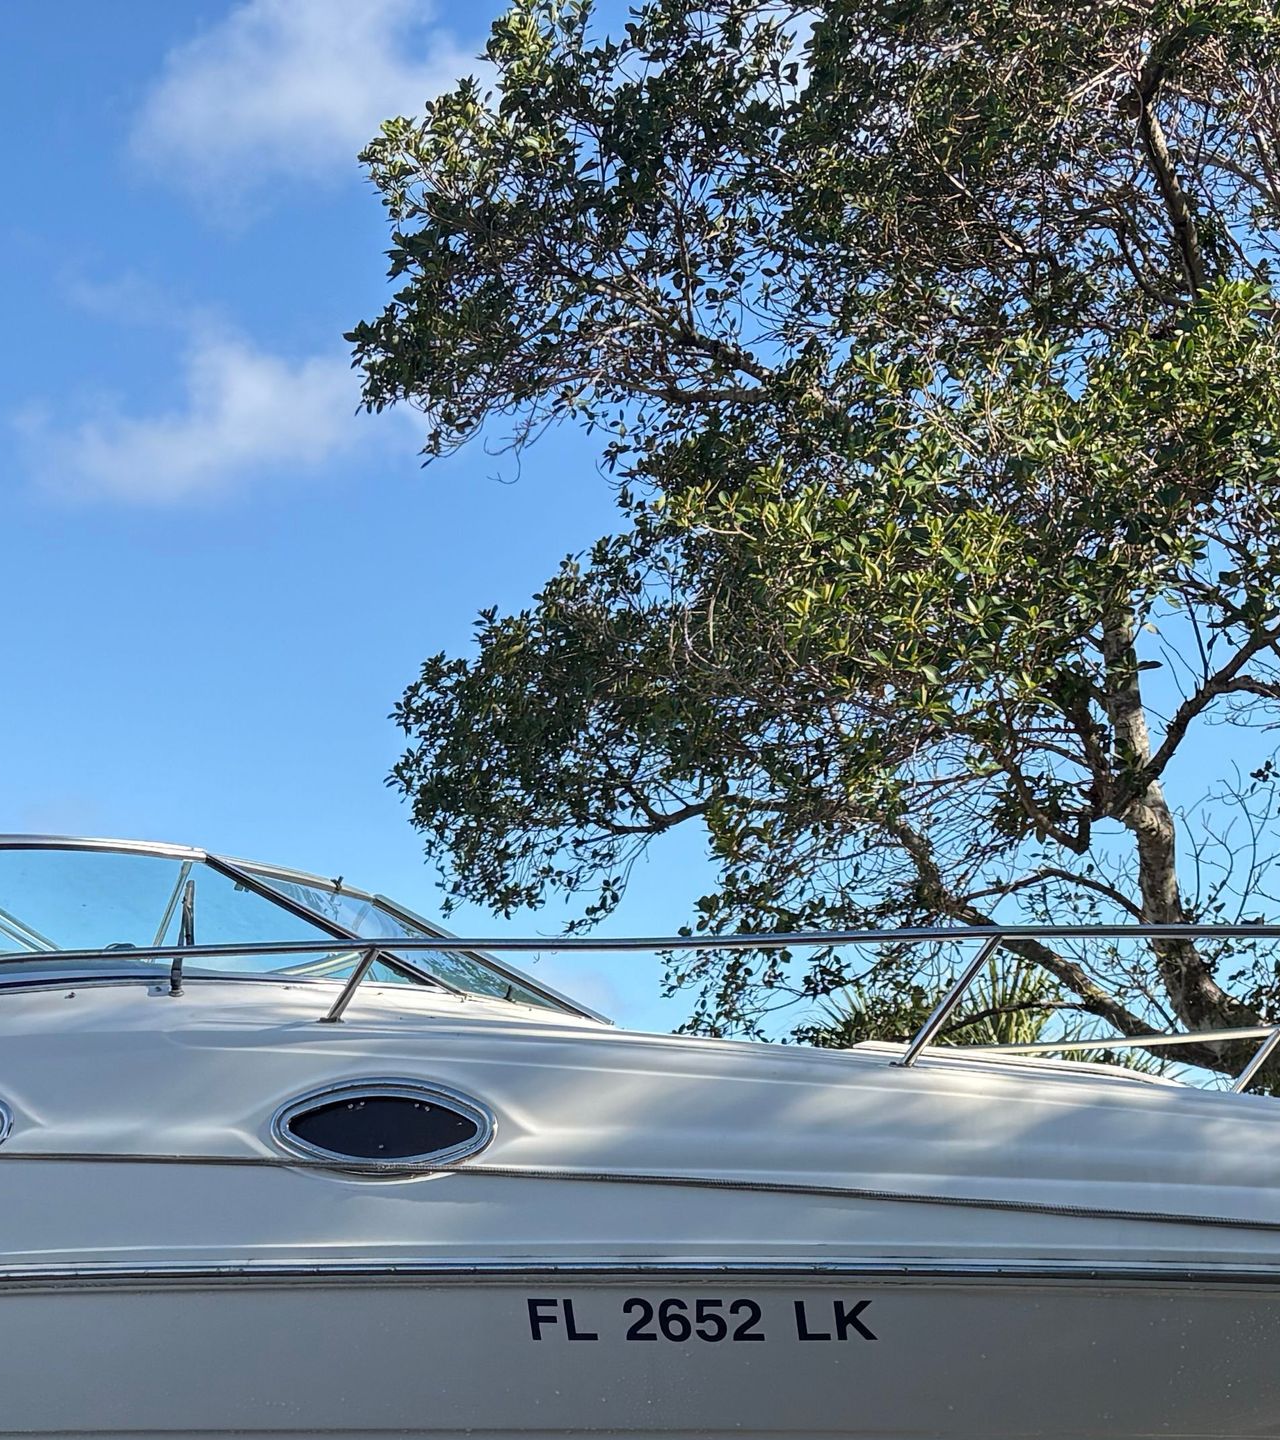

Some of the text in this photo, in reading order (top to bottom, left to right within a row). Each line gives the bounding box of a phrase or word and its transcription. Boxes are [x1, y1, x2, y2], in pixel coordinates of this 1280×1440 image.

[527, 1298, 878, 1342] FL 2652 LK
